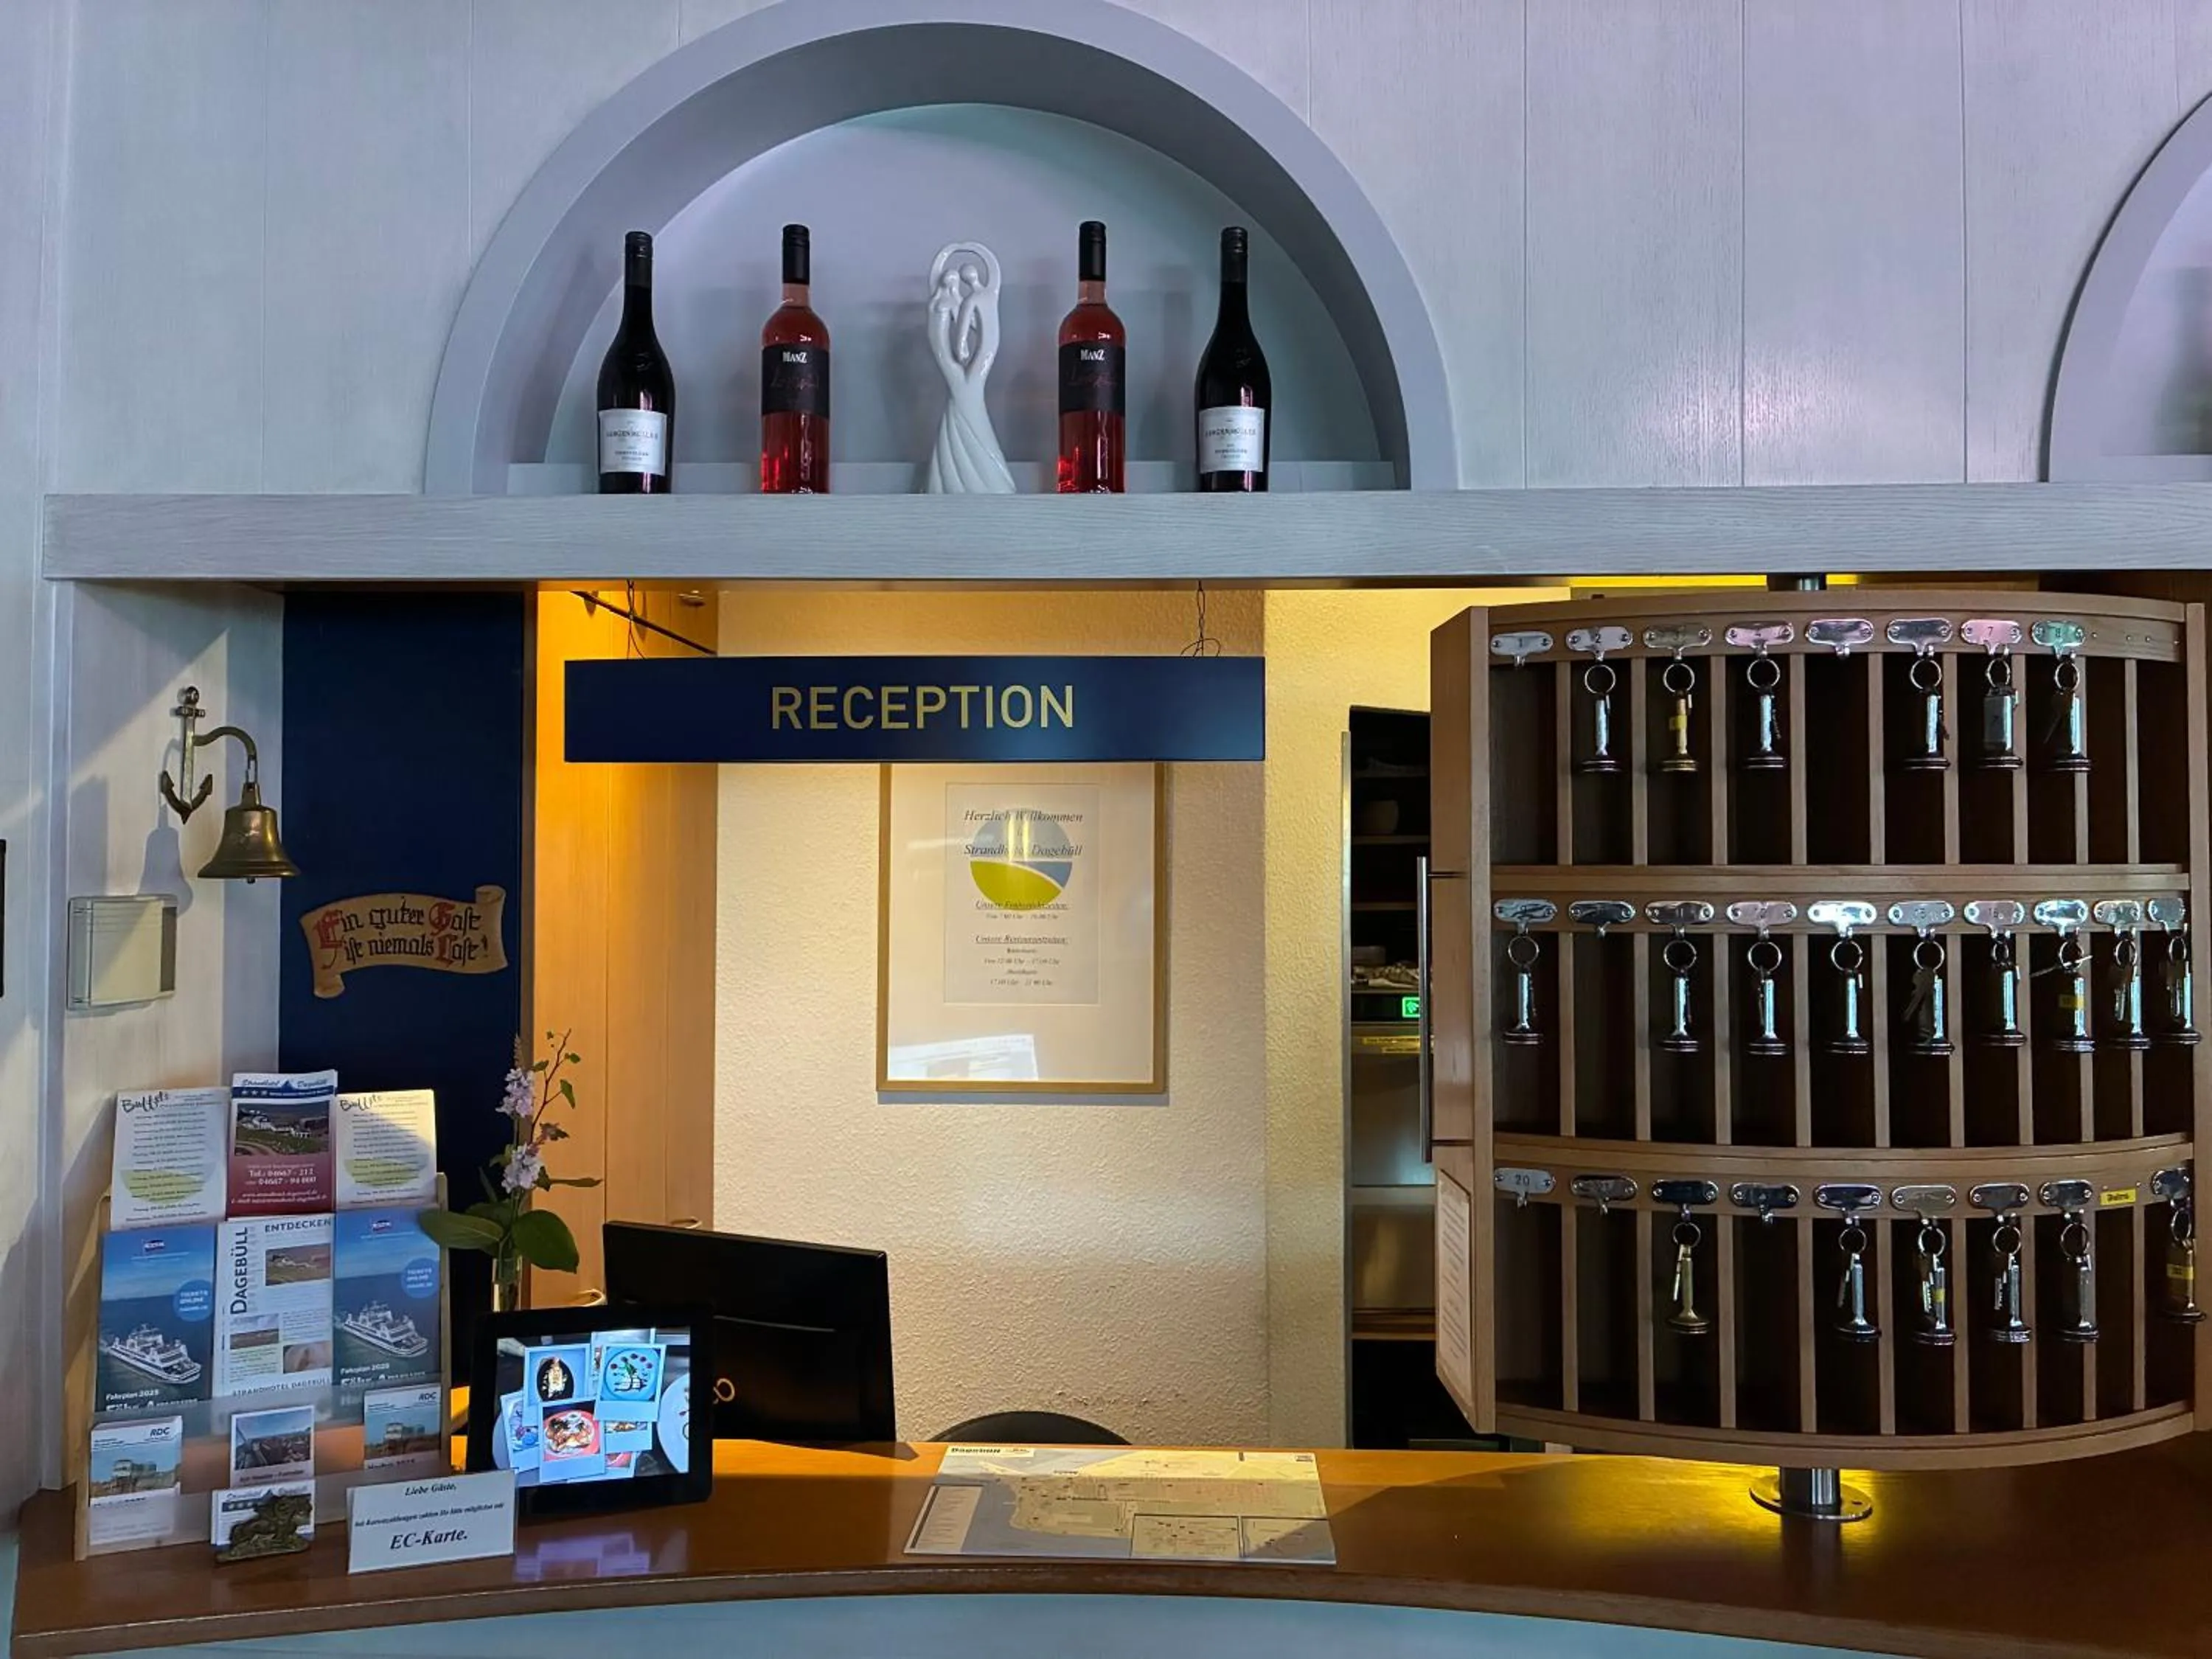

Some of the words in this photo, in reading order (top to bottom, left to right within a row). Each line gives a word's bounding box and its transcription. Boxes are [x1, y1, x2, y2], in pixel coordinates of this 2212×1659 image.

[771, 685, 1074, 731] RECEPTION
[964, 810, 1012, 821] Herzlich
[369, 932, 434, 956] niemals
[1515, 1174, 1529, 1187] 20
[265, 1218, 331, 1233] ENTDECKEN
[230, 1227, 248, 1315] DAGEBÜLL
[150, 1427, 170, 1437] RDC
[390, 1526, 468, 1551] EC-Karte.
